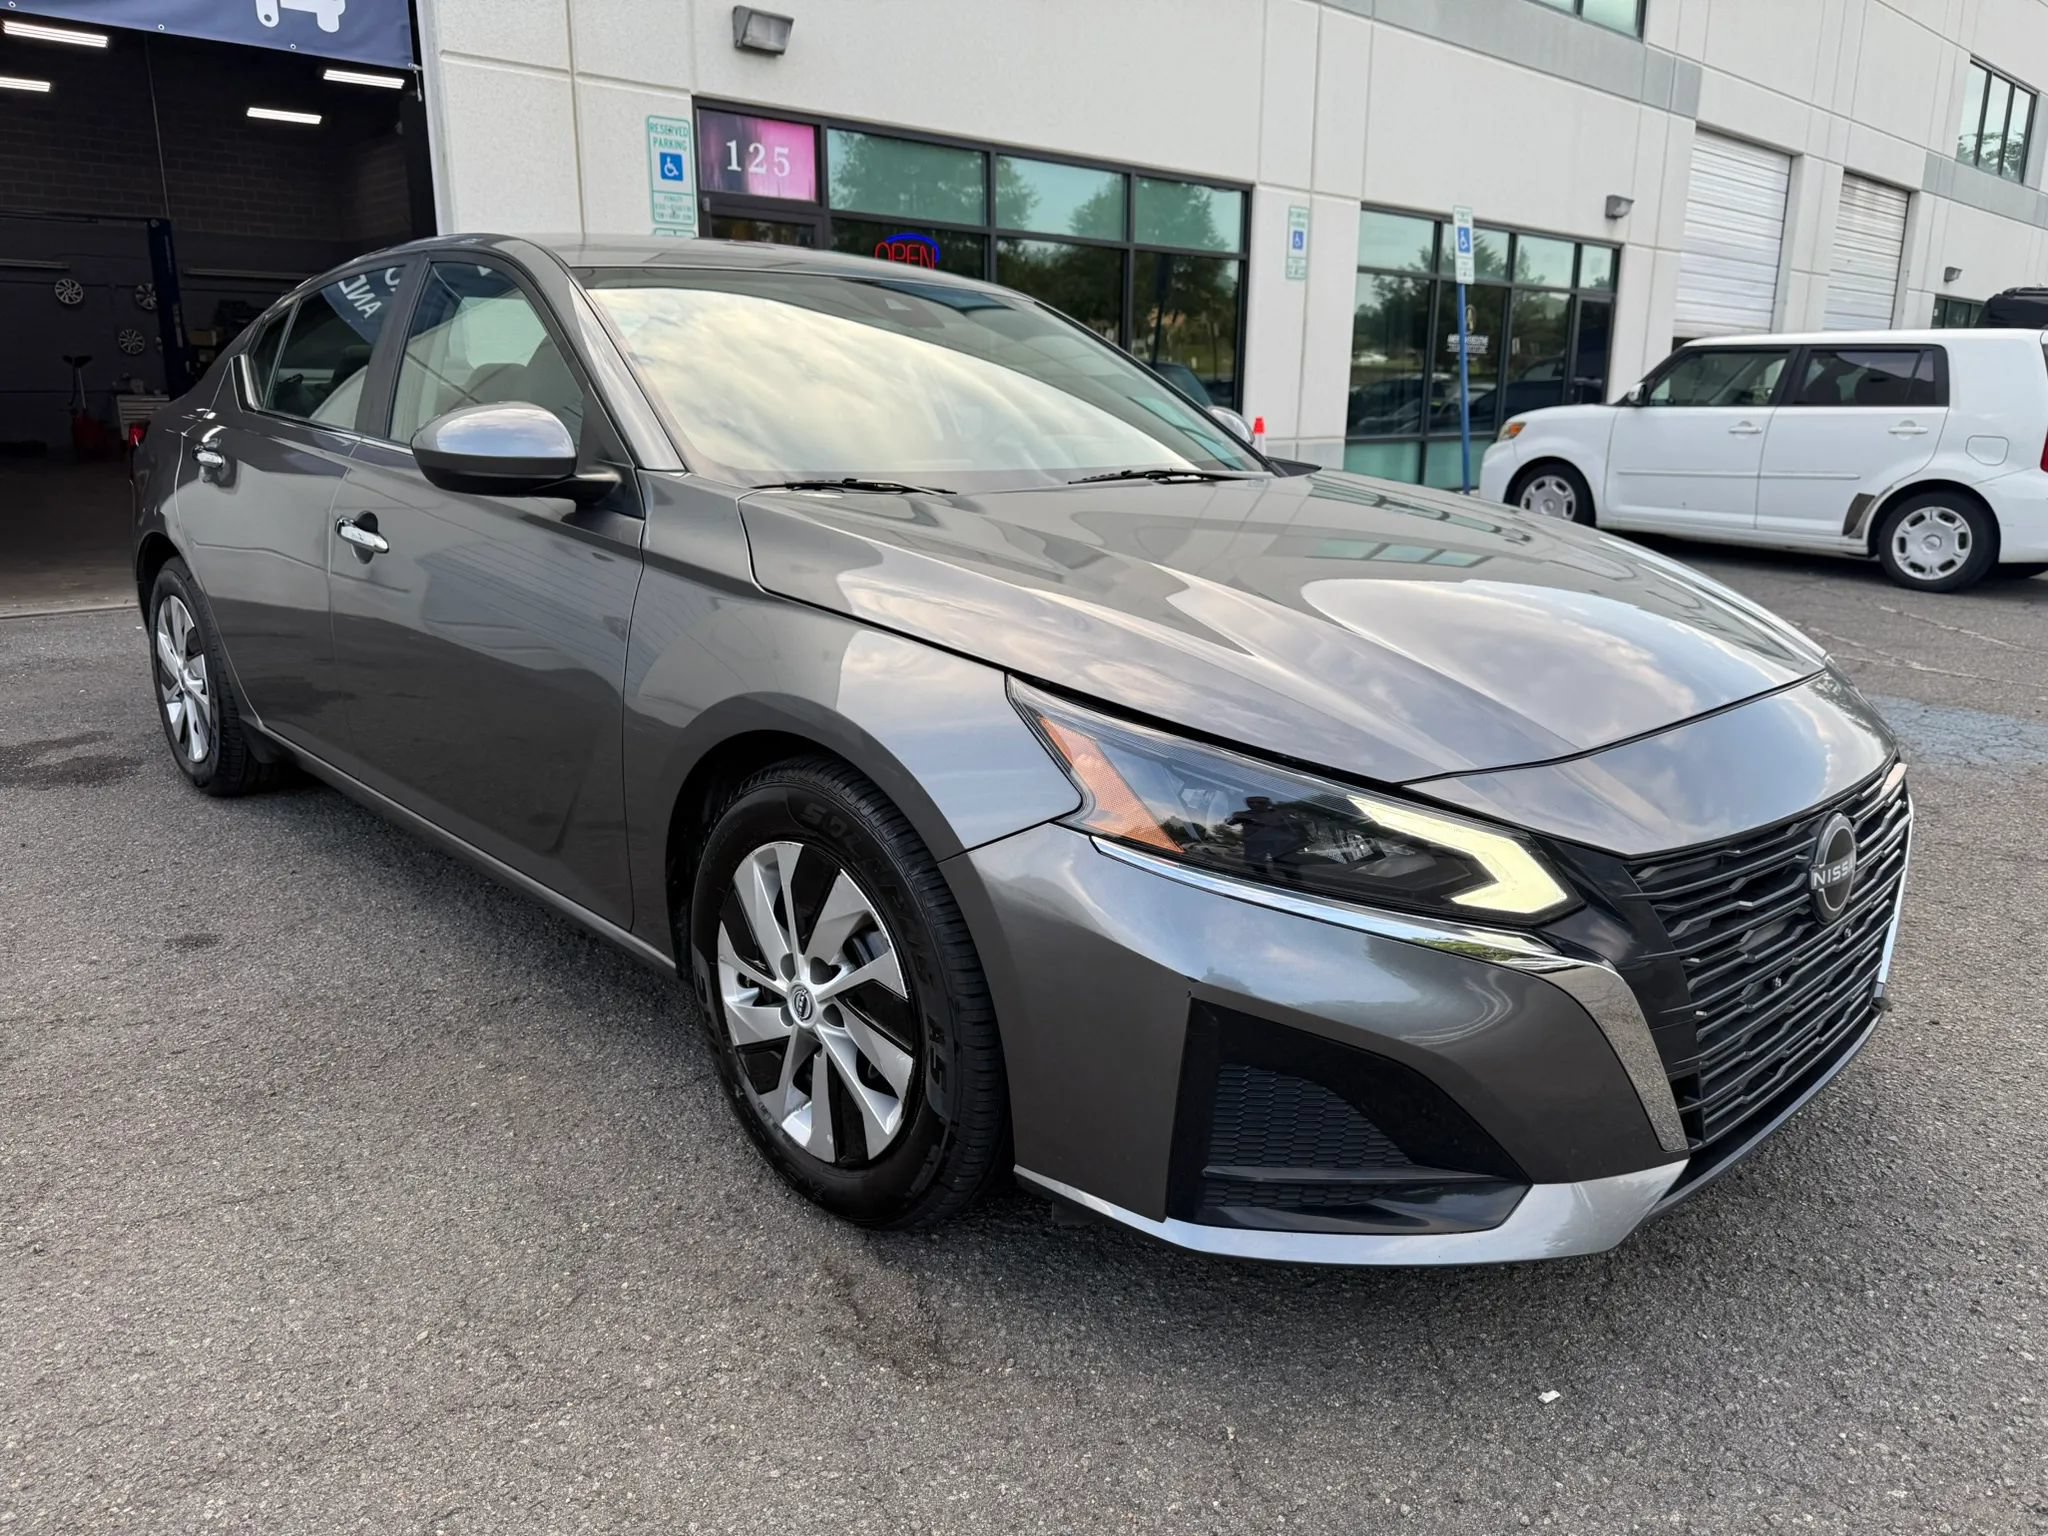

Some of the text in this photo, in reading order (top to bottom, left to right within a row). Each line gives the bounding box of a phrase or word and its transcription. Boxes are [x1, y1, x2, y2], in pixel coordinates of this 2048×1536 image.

[649, 123, 688, 137] RESERVED
[653, 137, 688, 152] PARKING
[725, 139, 791, 177] 125
[1813, 858, 1853, 887] NISS
